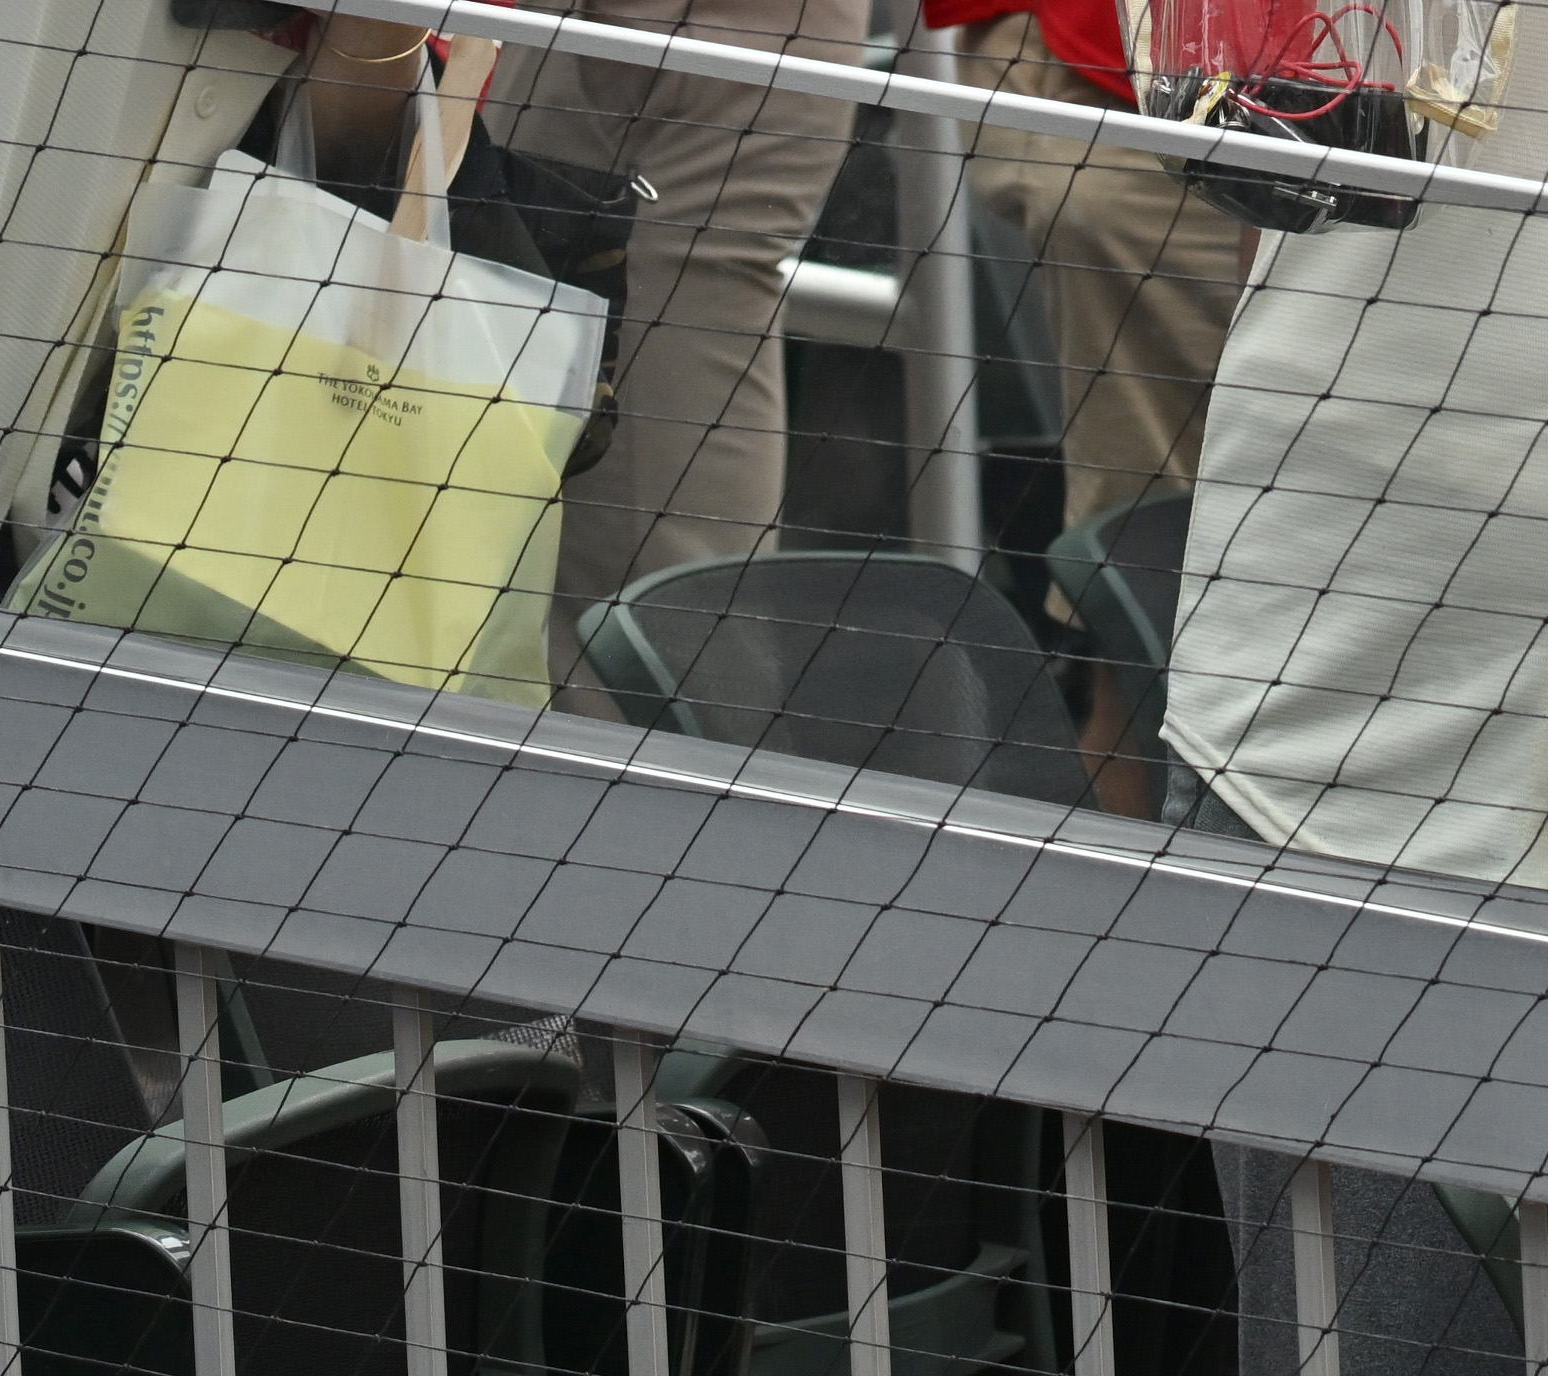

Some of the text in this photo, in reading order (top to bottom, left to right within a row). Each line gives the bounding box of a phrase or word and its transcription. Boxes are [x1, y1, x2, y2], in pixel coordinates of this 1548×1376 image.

[318, 372, 338, 389] THE
[402, 401, 423, 416] BAY
[331, 392, 402, 427] HOTEL TOKYU
